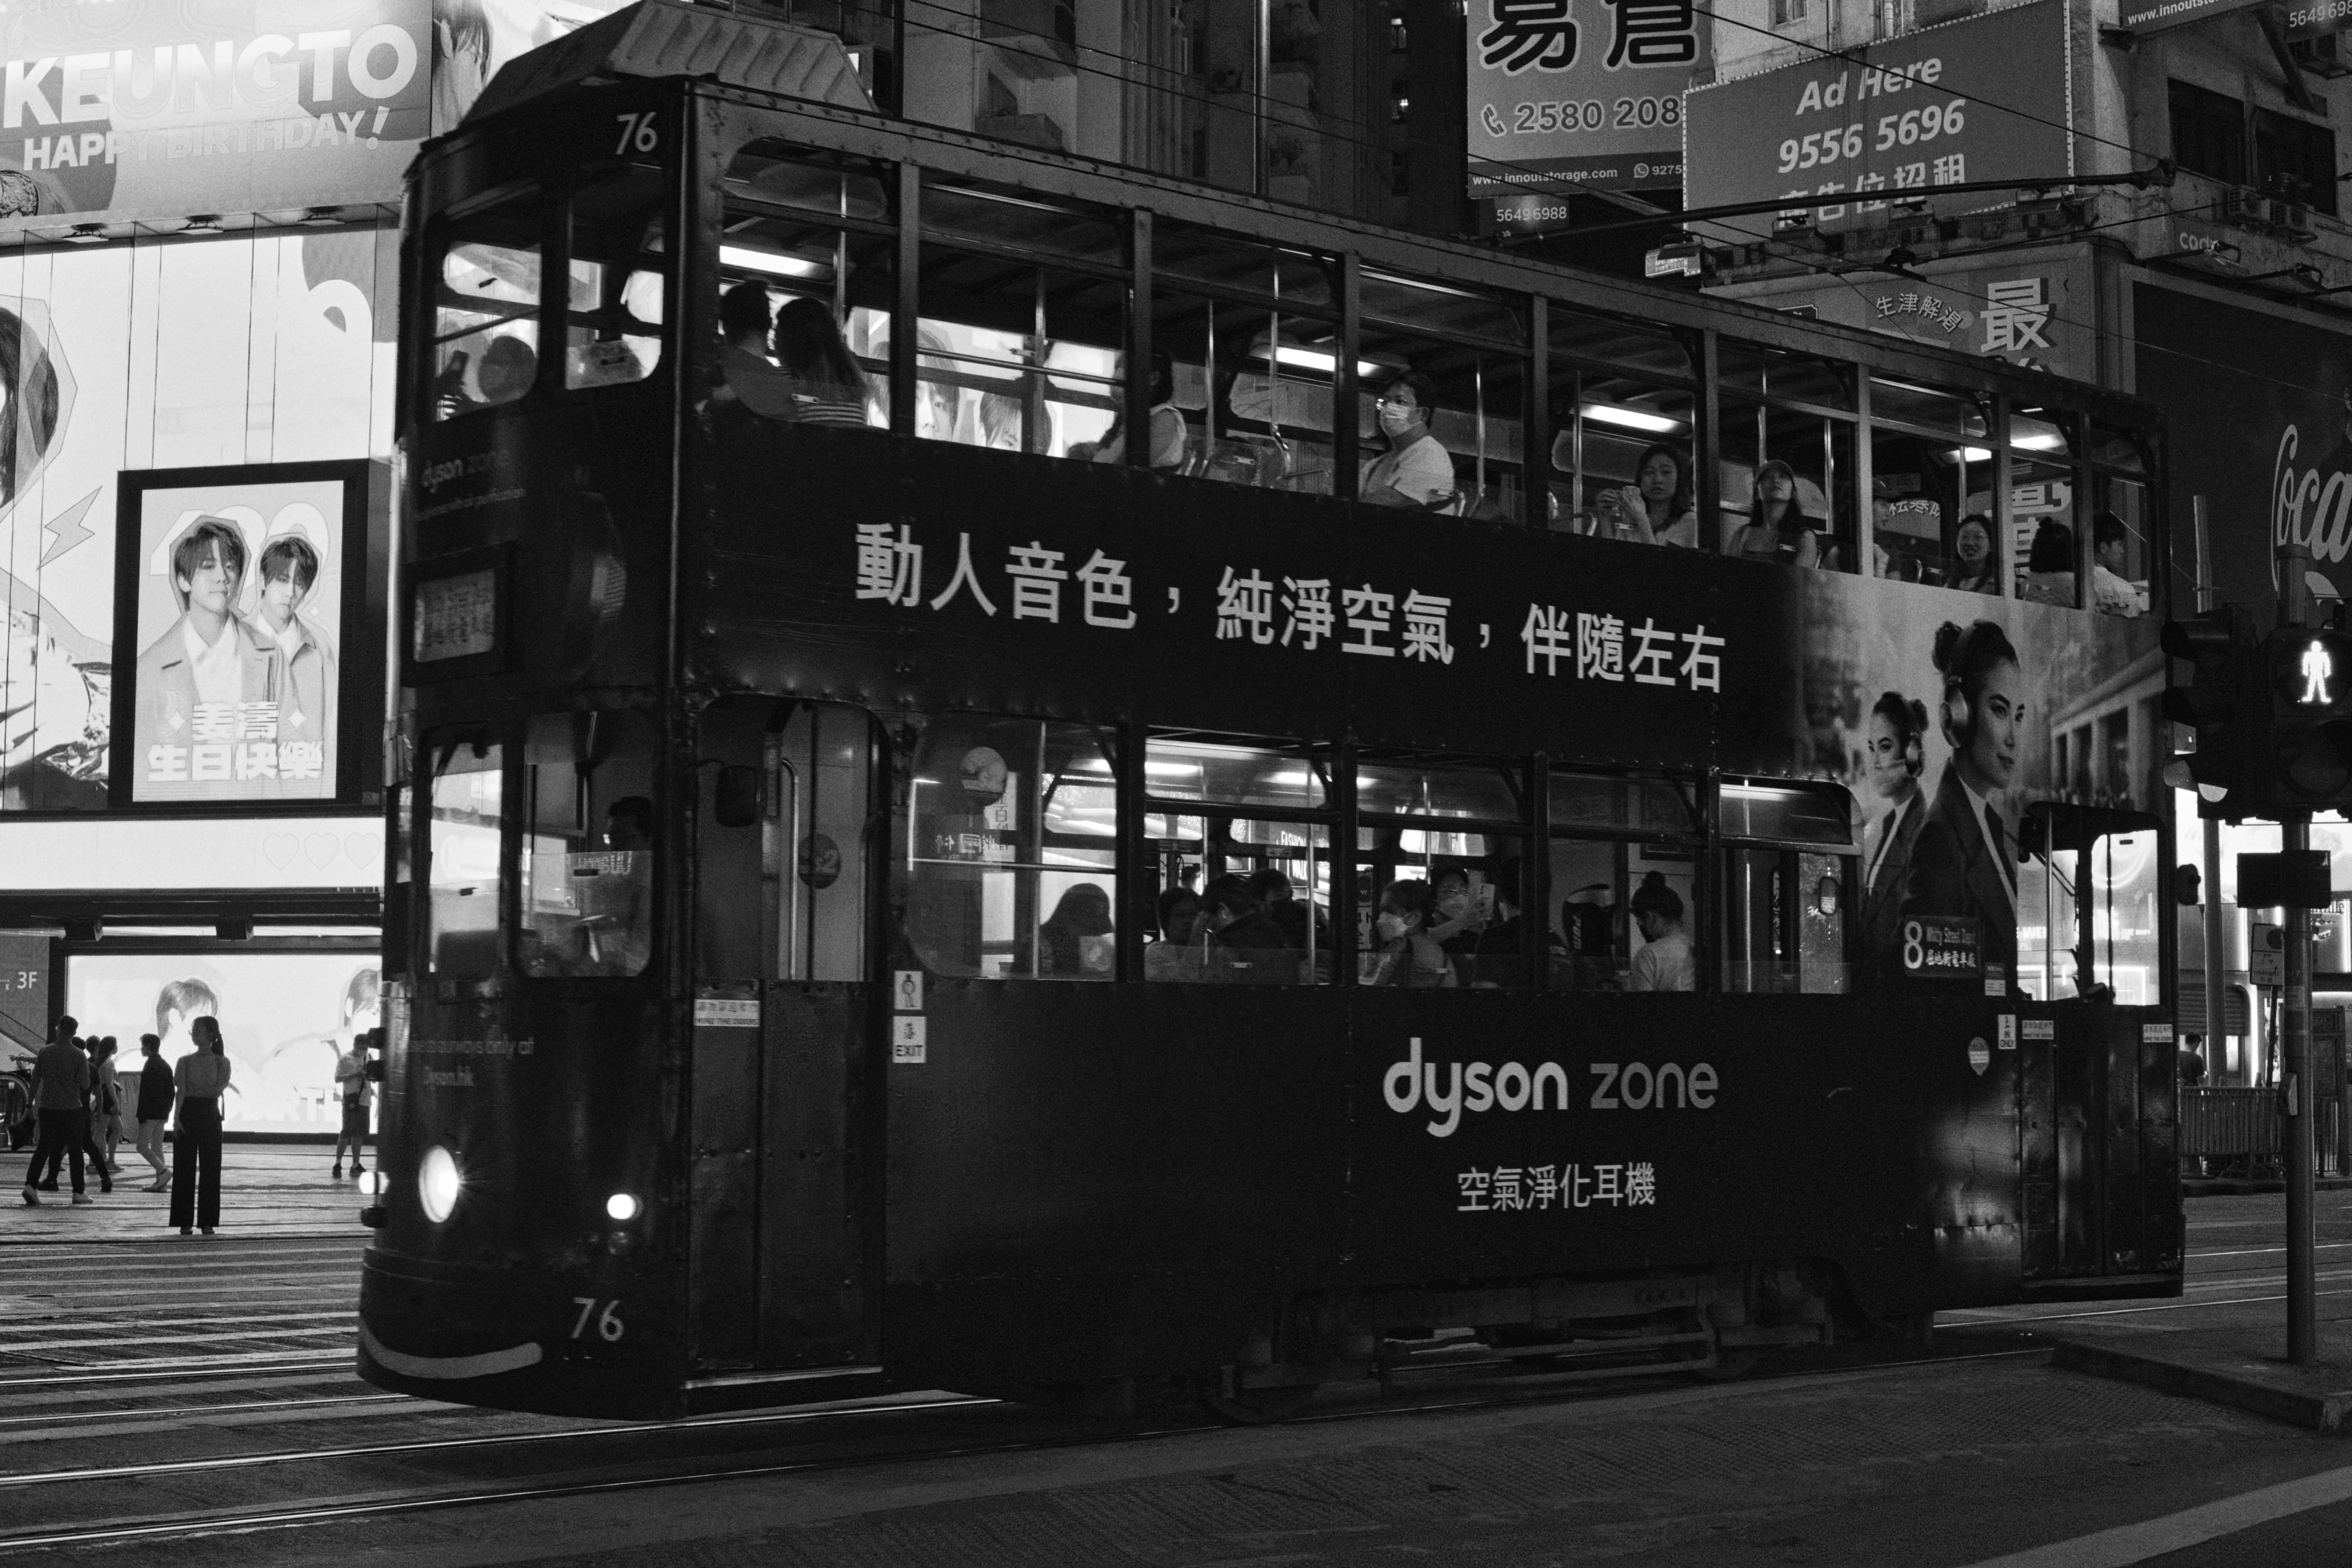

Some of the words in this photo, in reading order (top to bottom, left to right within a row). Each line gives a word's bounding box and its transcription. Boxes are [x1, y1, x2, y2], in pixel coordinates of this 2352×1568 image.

[1796, 71, 1848, 115] Ad
[1858, 58, 1942, 100] Here
[615, 111, 658, 155] 76
[1514, 99, 1604, 133] 2580
[1614, 95, 1683, 129] 208
[24, 130, 151, 171] HAPPY
[1778, 123, 1863, 173] 9556
[1876, 99, 1966, 151] 5696
[1473, 169, 1617, 185] www.innoutstorage.com
[1652, 165, 1683, 175] 9275
[1876, 292, 1962, 333] 生津解渴
[191, 701, 278, 741] 姜濤
[147, 740, 323, 782] 生日快樂
[1904, 921, 1923, 969] 8
[17, 971, 37, 989] 3F
[895, 1044, 923, 1057] EXIT
[1383, 1037, 1568, 1138] dyson
[1589, 1061, 1720, 1110] zone
[1457, 1161, 1657, 1212] 空氣淨化耳機
[571, 1296, 625, 1341] 76
